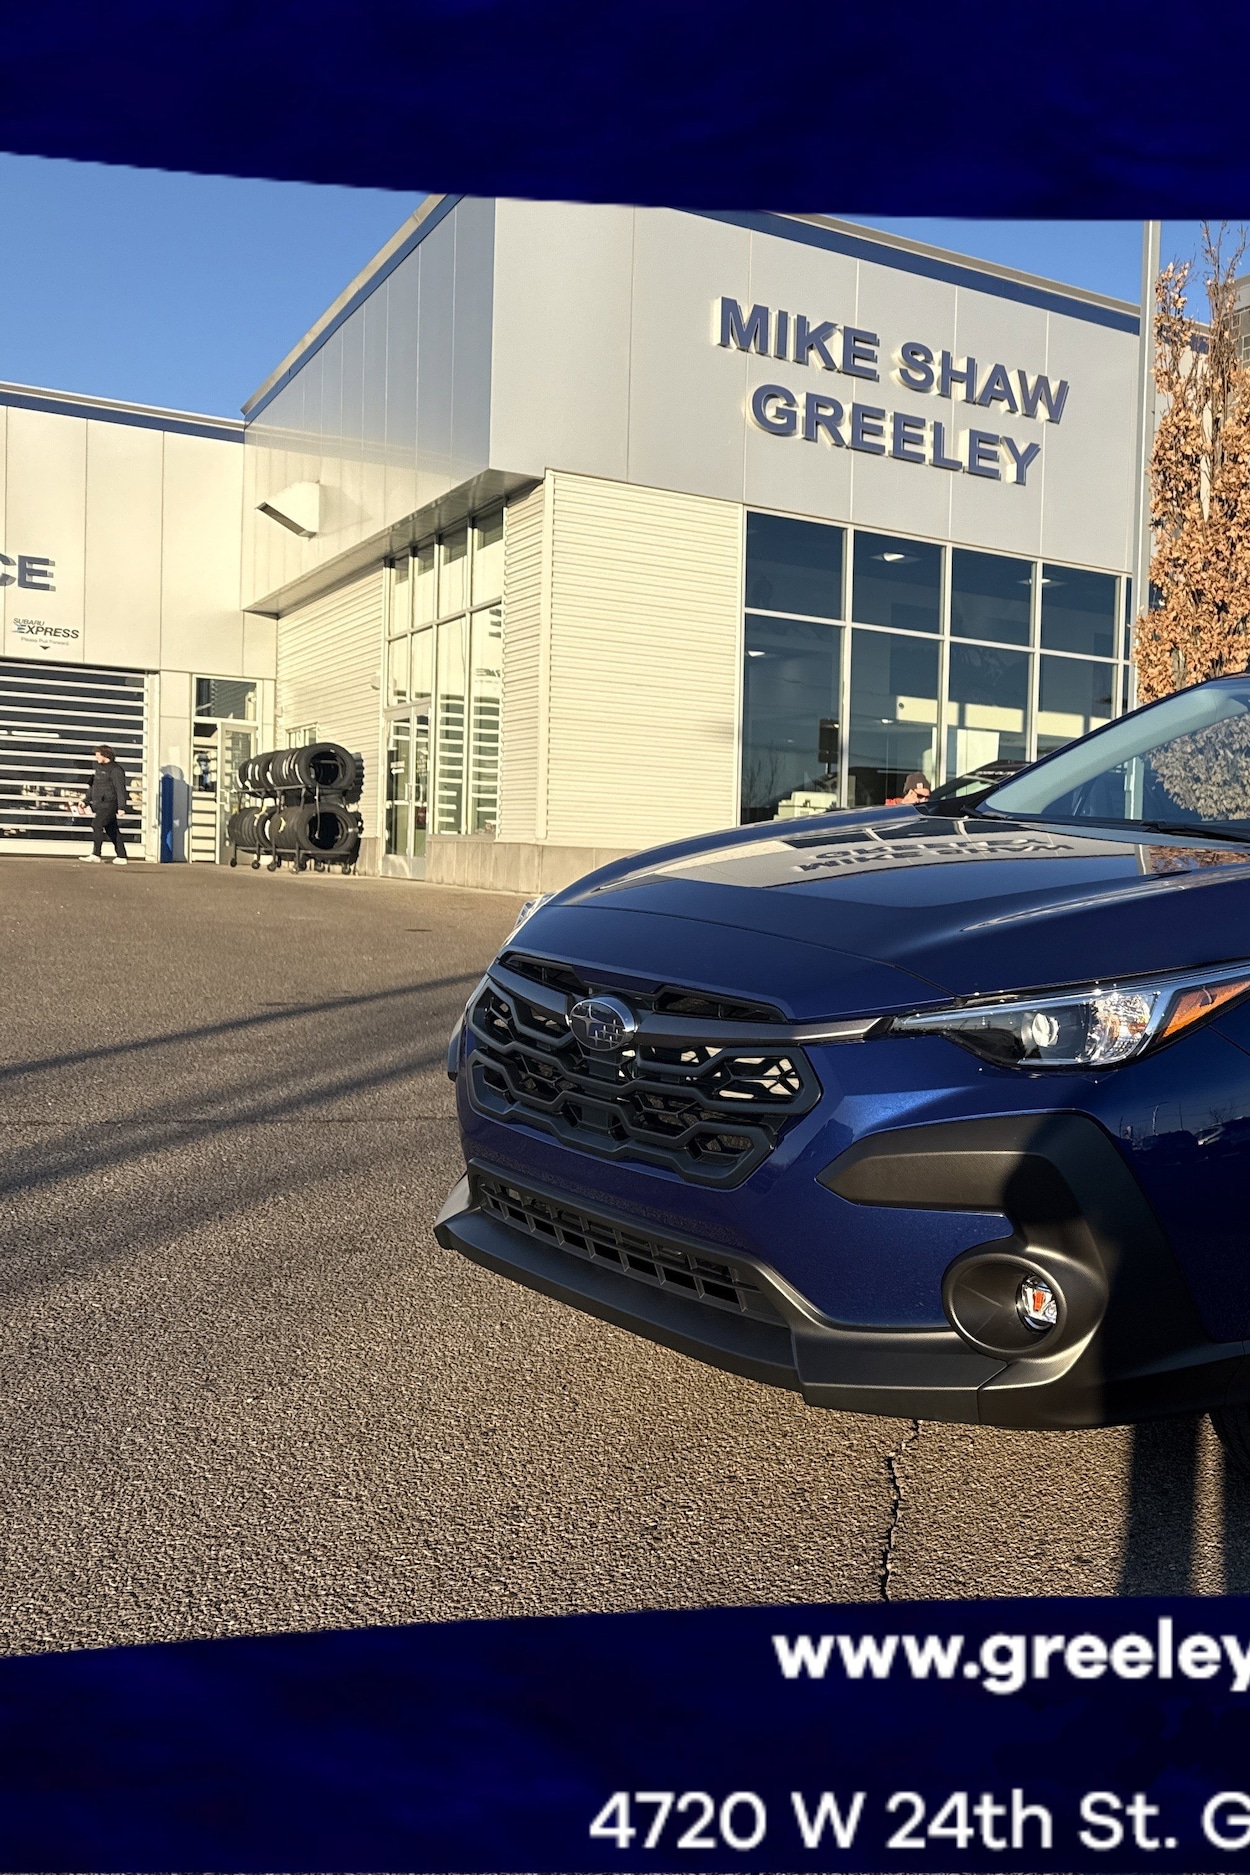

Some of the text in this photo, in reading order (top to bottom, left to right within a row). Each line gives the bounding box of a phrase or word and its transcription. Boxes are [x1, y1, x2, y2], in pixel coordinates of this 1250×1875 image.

[717, 296, 1070, 425] MIKE SHAW
[750, 384, 1041, 486] GREELEY
[13, 617, 45, 627] SUBARU
[16, 624, 80, 639] EXPRESS
